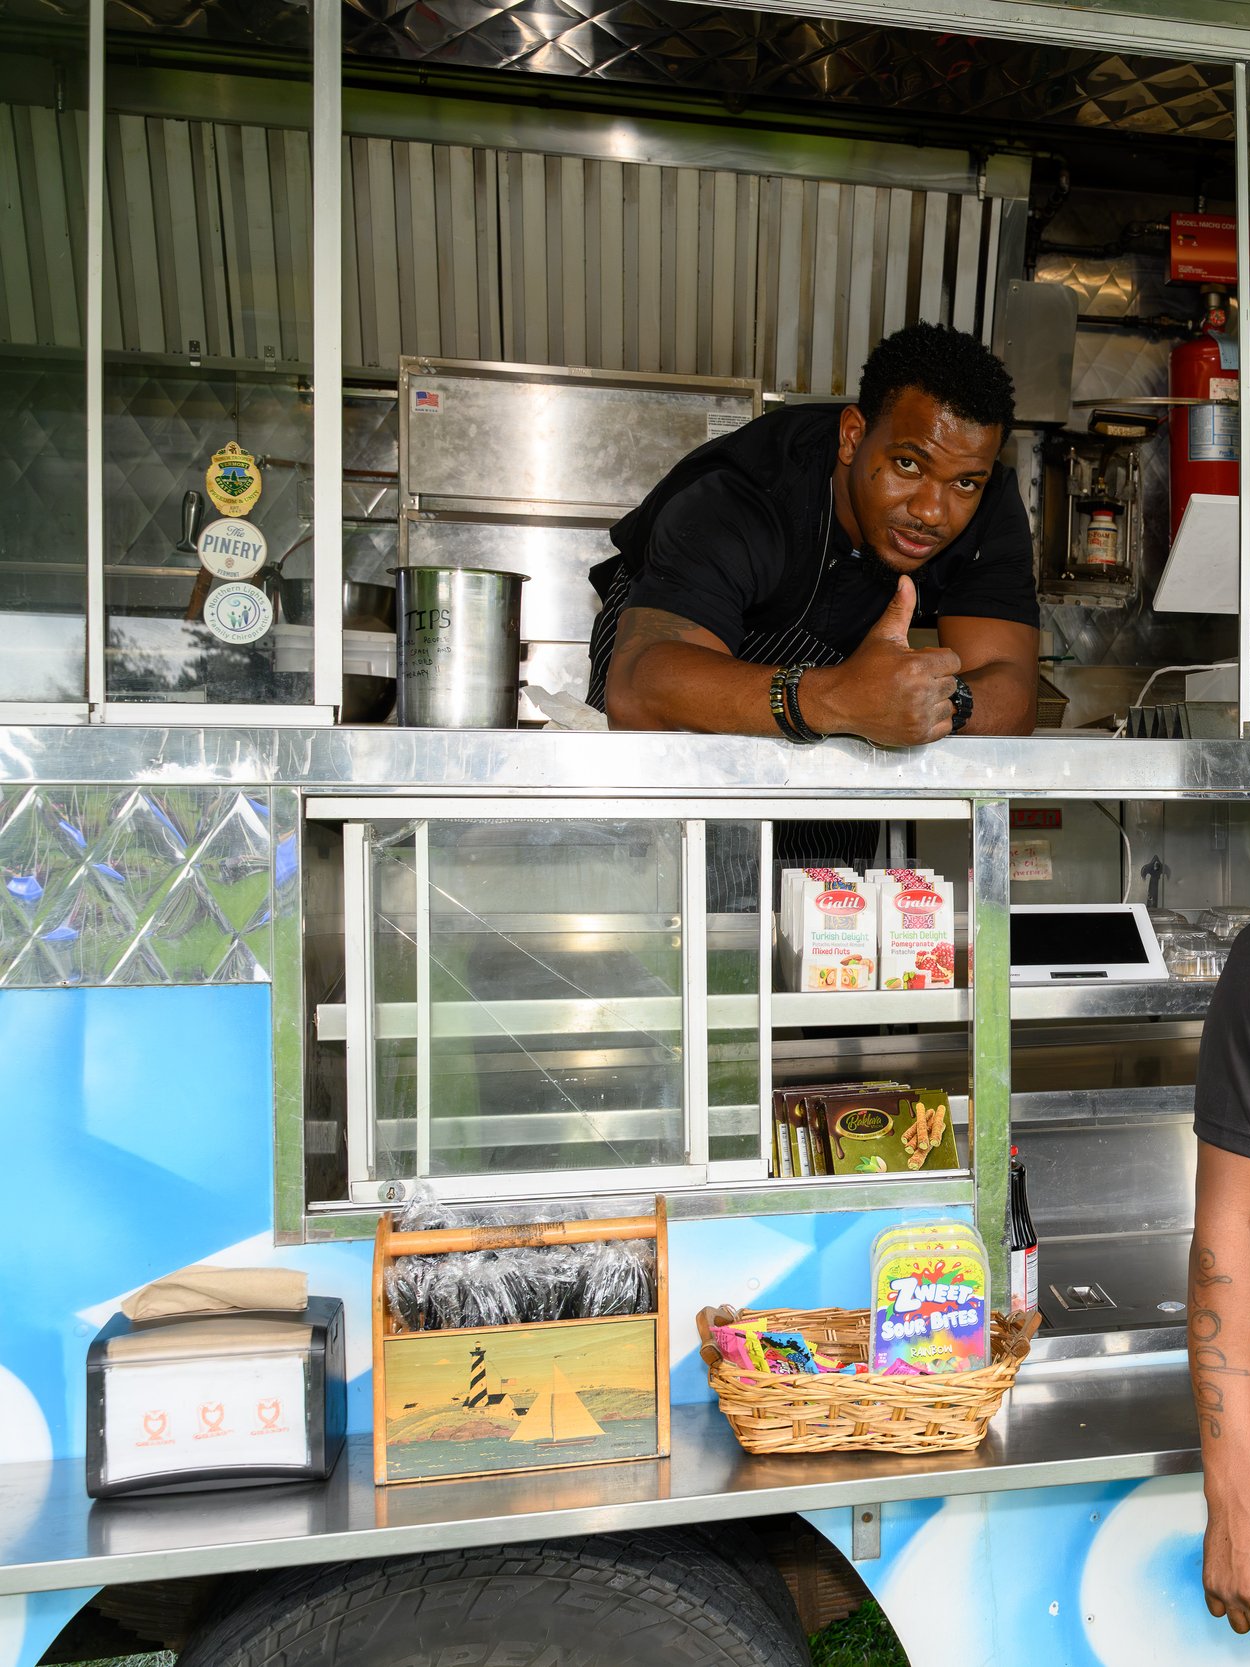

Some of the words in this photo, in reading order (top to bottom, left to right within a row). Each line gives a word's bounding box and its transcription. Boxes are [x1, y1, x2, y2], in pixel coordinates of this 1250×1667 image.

[215, 477, 232, 493] STATE
[235, 478, 253, 495] POLICE
[210, 489, 237, 503] FREEDOM
[244, 490, 259, 502] UNITY
[226, 526, 246, 538] The
[202, 534, 262, 562] PINERY
[217, 568, 240, 578] VERMONT
[209, 586, 240, 608] Northern
[243, 586, 264, 605] Lights
[210, 619, 230, 638] Family
[232, 615, 269, 640] Chiropractic
[404, 609, 450, 631] TIPS
[818, 896, 860, 909] Galil
[897, 895, 938, 909] Galil
[811, 932, 839, 940] Turkish
[842, 932, 869, 942] Delight
[889, 931, 918, 939] Turkish
[920, 931, 947, 941] Delight
[846, 1113, 882, 1131] Baklava
[890, 1276, 973, 1312] ZWEET
[881, 1318, 927, 1341] SOUR
[930, 1309, 978, 1331] BITES
[911, 1344, 952, 1357] RAINBOW
